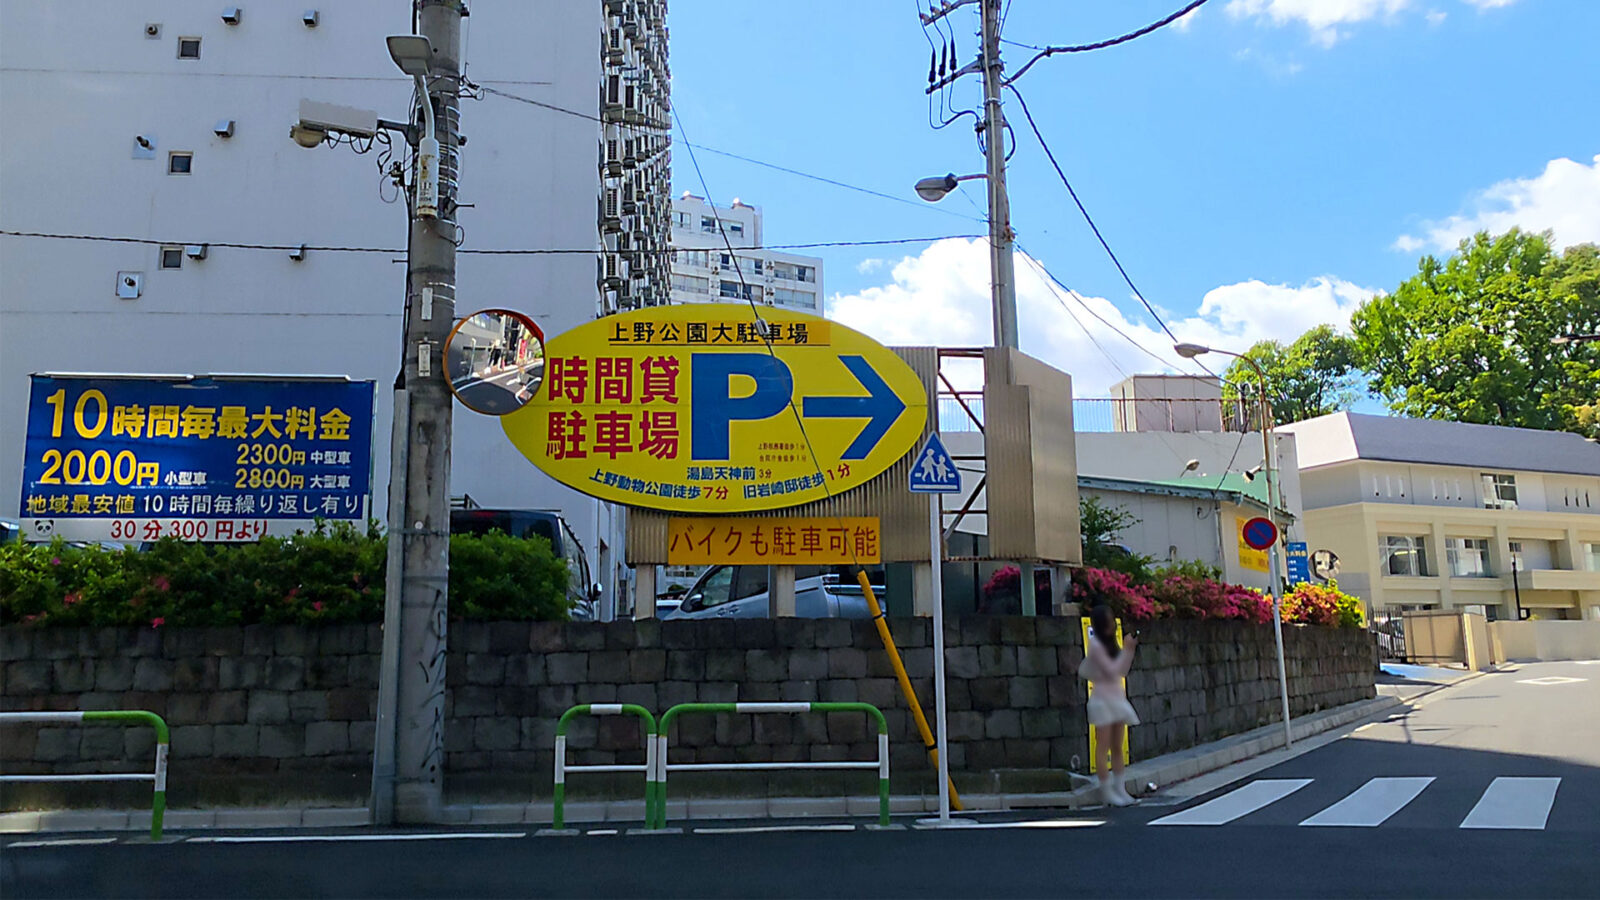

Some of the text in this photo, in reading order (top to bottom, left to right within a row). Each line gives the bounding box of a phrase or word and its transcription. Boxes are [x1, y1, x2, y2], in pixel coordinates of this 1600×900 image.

[608, 321, 808, 344] 上野公園大駐車場
[547, 355, 679, 404] 時間貸
[46, 388, 352, 441] 10時間毎最大料金
[691, 352, 794, 460] P
[546, 410, 679, 460] 駐車場
[40, 449, 207, 486] 2000円 小型車
[236, 443, 351, 466] 2300円 中型車
[235, 468, 350, 490] 2800円 大型車
[588, 468, 729, 500] 上野動物公園徒歩7分
[743, 462, 851, 500] 旧岩崎邸徒歩1分
[26, 494, 135, 515] 地域最安値
[670, 525, 877, 558] バイクも駐車可能
